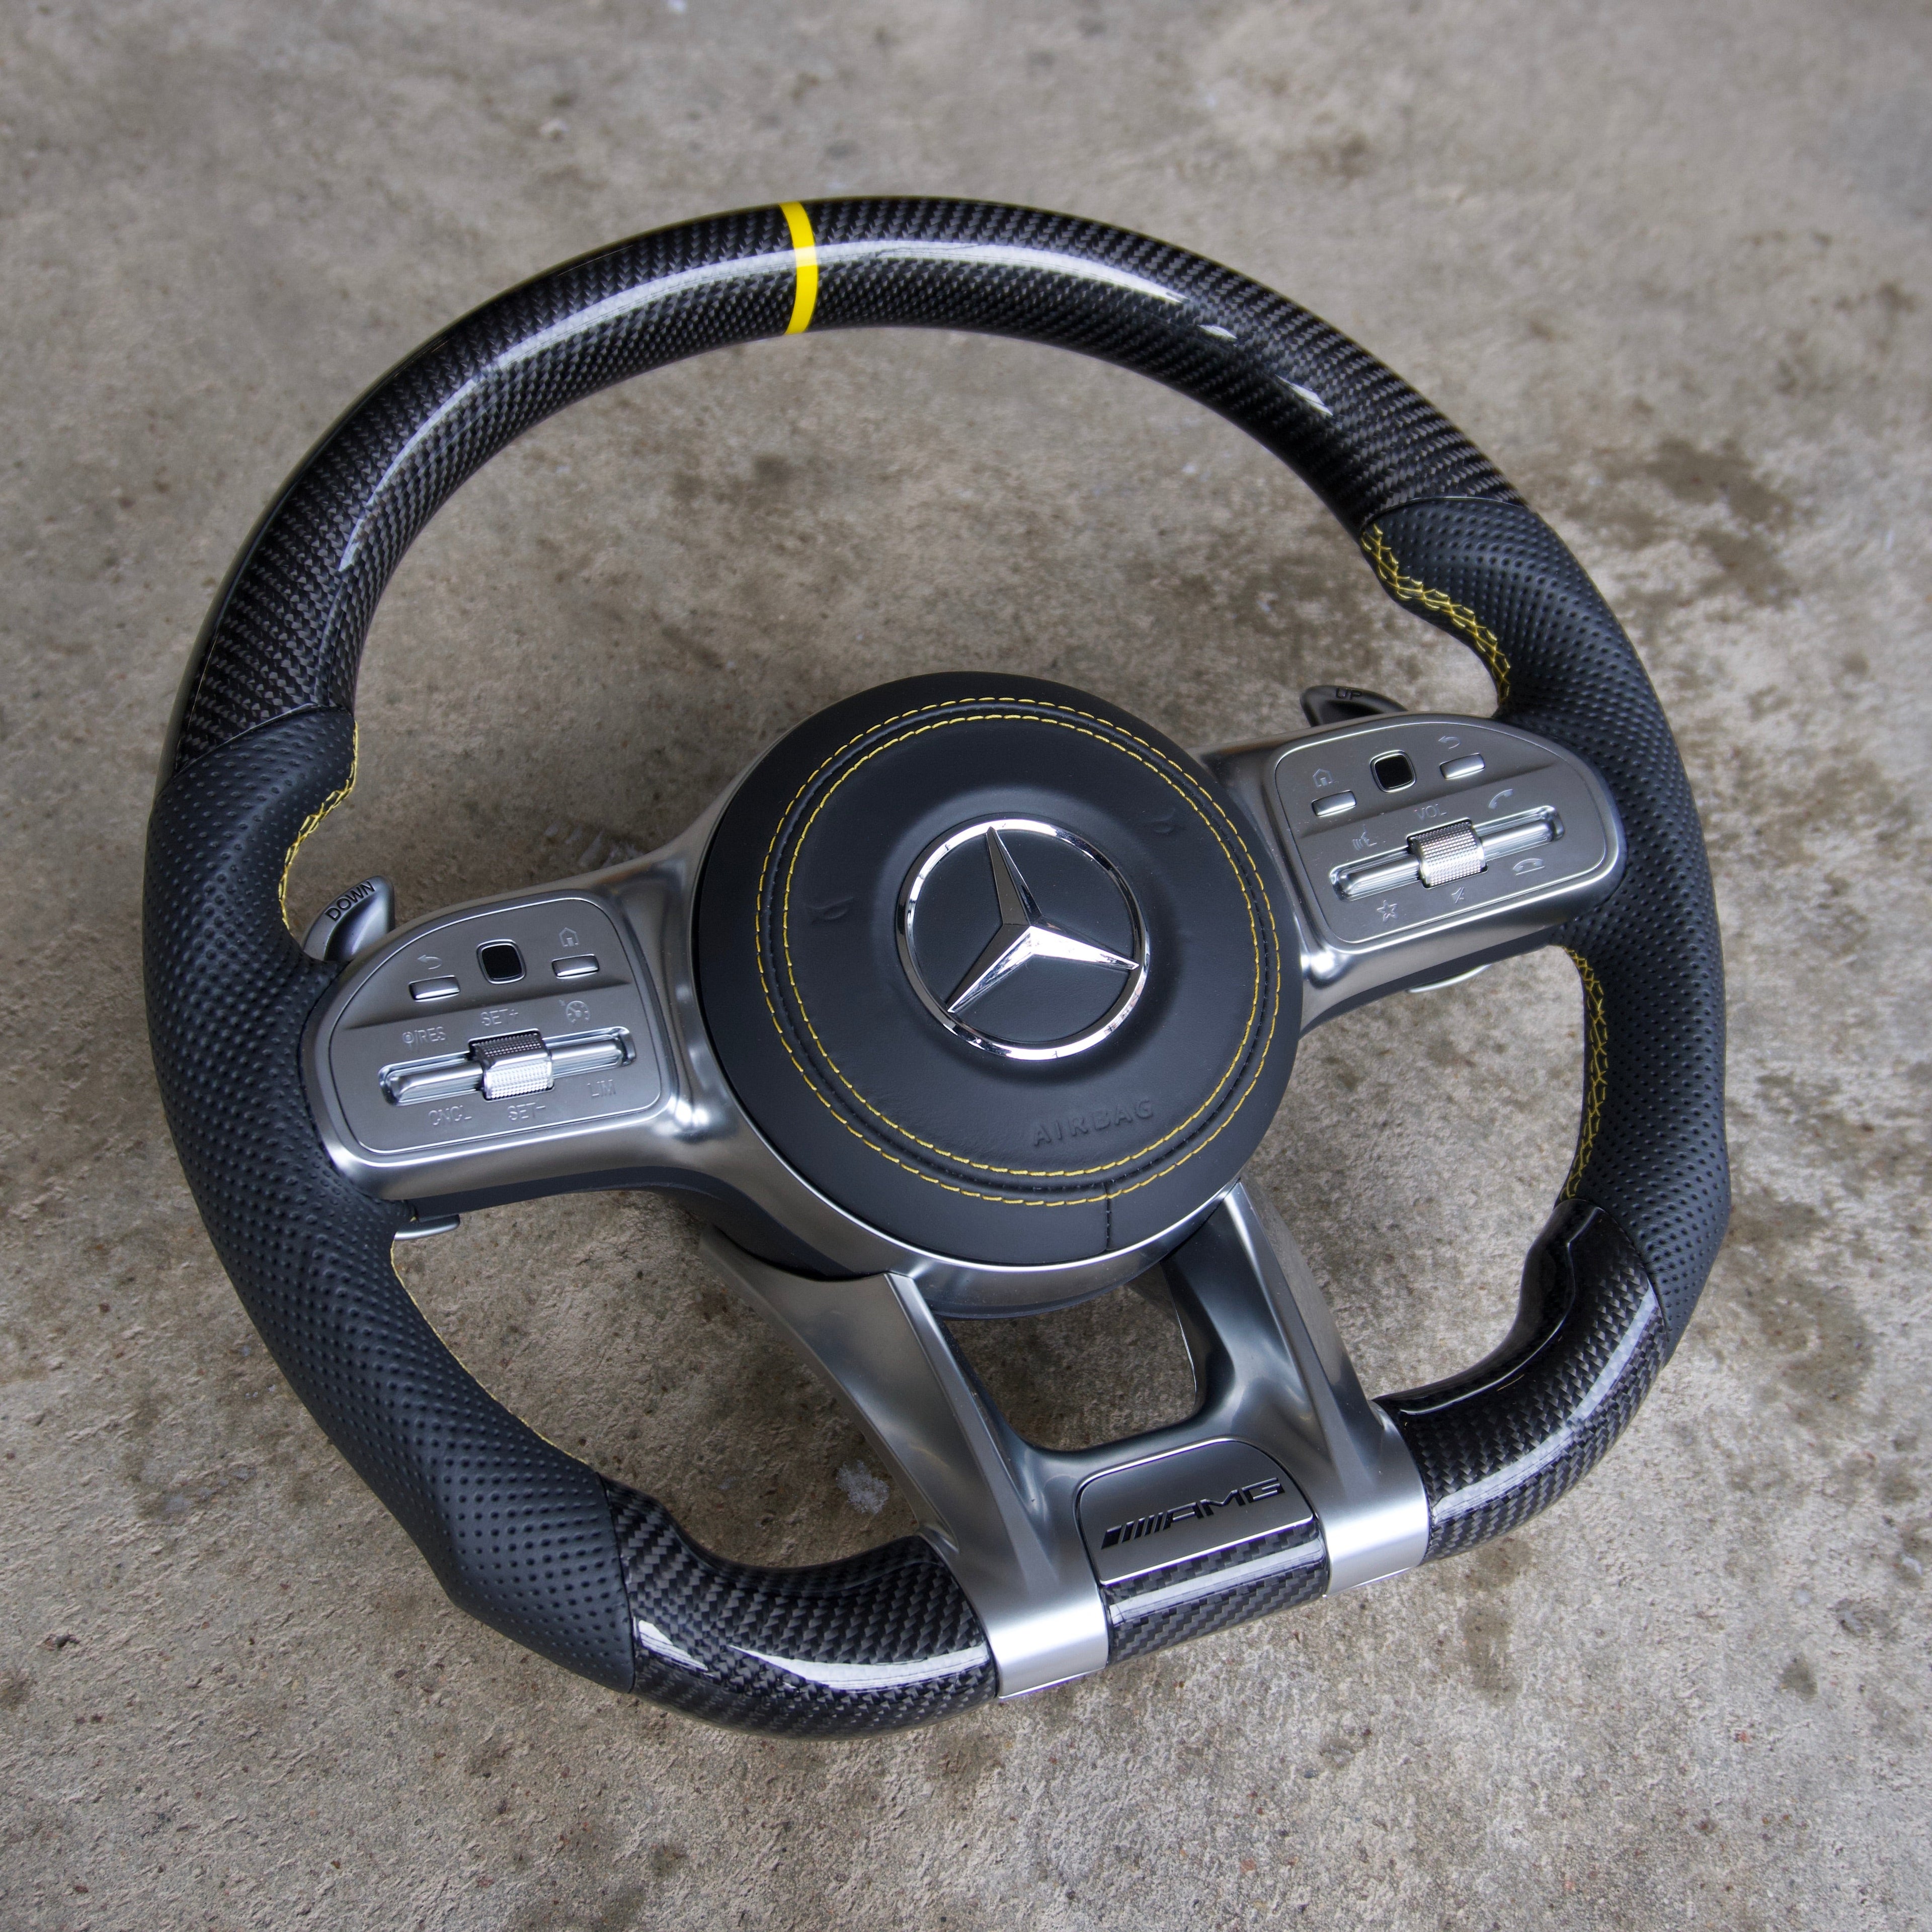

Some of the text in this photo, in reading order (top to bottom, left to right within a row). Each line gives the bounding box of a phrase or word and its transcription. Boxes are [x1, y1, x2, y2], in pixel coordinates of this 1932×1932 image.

[1335, 687, 1362, 701] UP
[1414, 803, 1446, 820] VOL
[325, 880, 375, 921] DOWN
[587, 1079, 616, 1097] LIM
[428, 1104, 472, 1125] CNCL
[1033, 1099, 1154, 1147] AIRBAG
[1162, 1477, 1285, 1531] AMG
